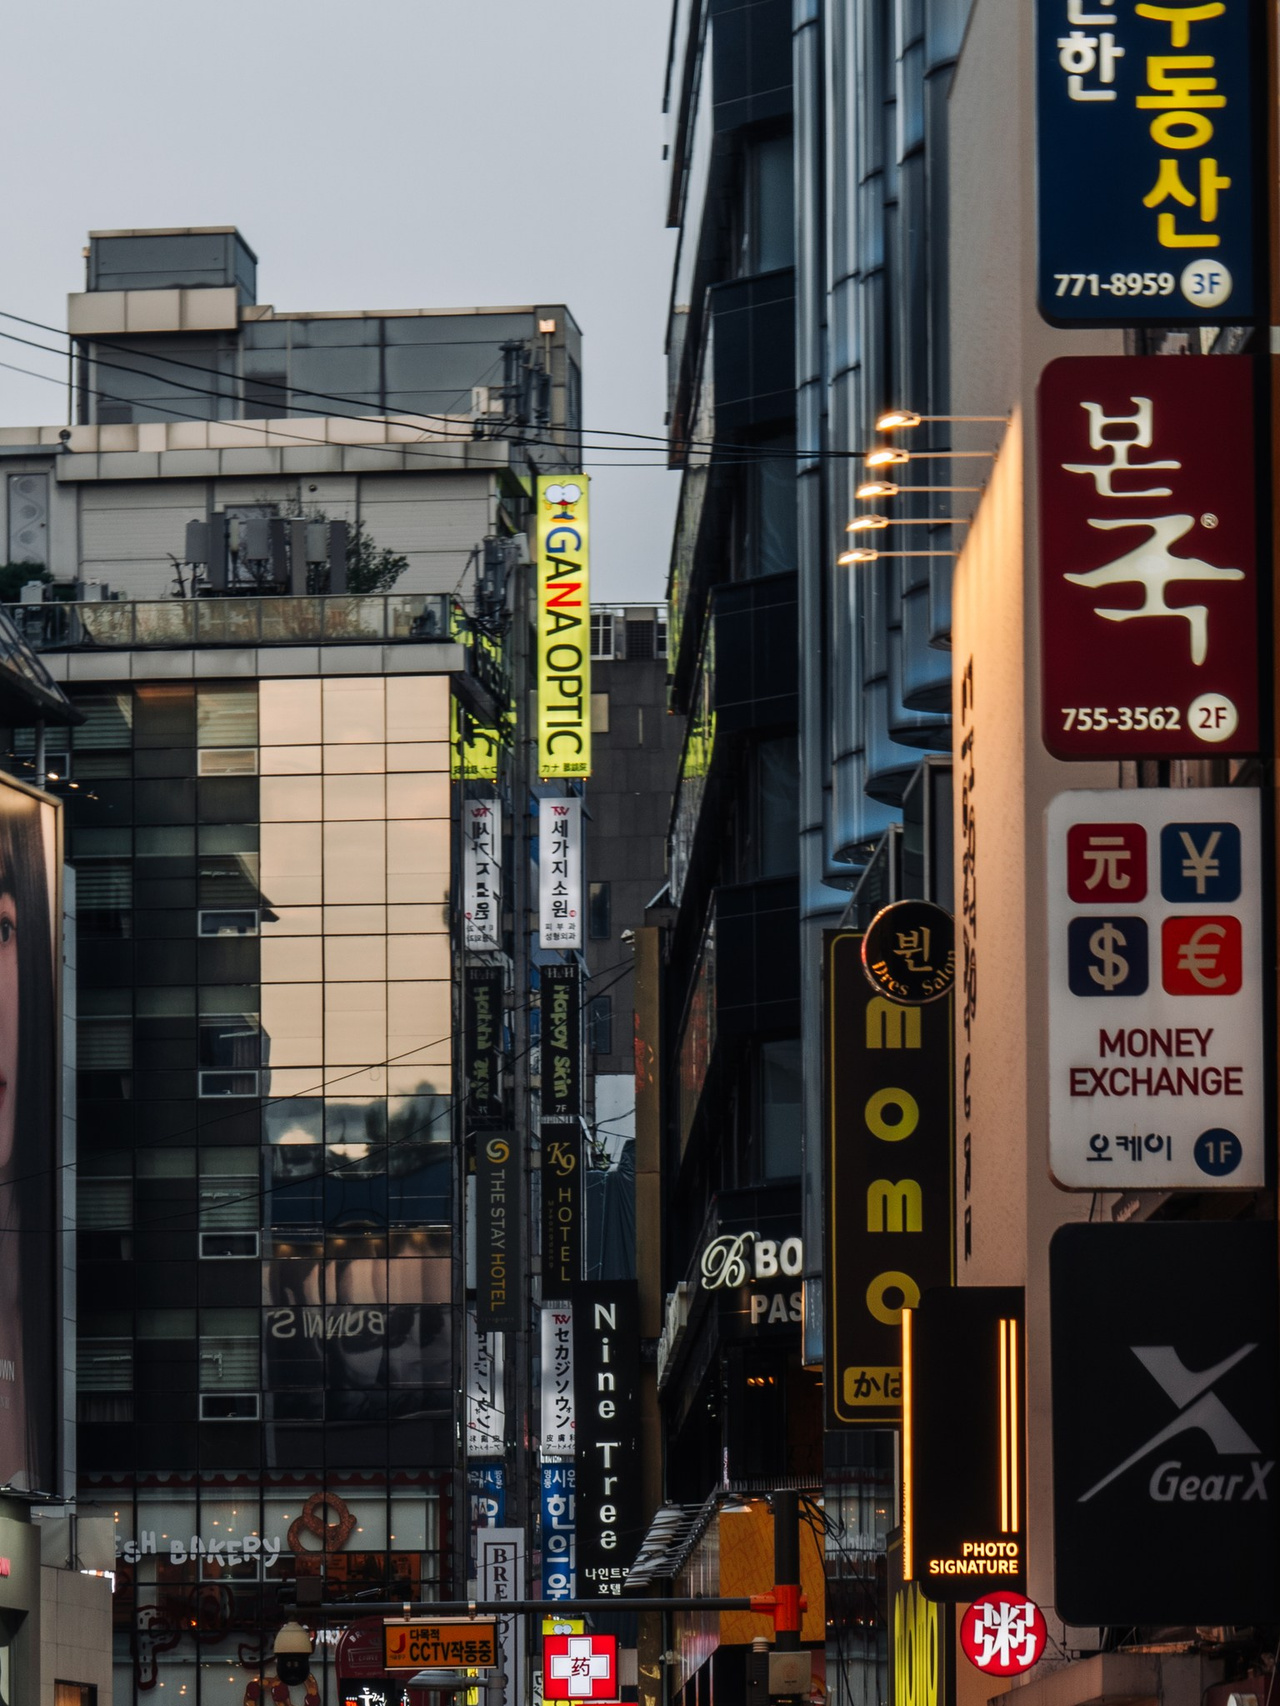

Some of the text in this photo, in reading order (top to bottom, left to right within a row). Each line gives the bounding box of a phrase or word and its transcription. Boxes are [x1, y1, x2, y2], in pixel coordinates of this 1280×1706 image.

[1053, 272, 1222, 297] 771-8959 3F
[1061, 396, 1246, 667] 본죽
[545, 526, 583, 756] GANA OPTIC
[1061, 706, 1228, 732] 755-3562 2F
[551, 819, 569, 918] 세가지소원
[1082, 836, 1131, 890] 元
[545, 932, 576, 941] 성형외과
[551, 985, 569, 1098] Happy Skin
[1098, 1028, 1214, 1057] MONEY
[1069, 1066, 1244, 1097] EXCHANGE
[555, 1105, 567, 1113] 7F
[547, 1142, 576, 1176] K9
[1085, 1132, 1233, 1162] 오케이 1F
[490, 1169, 506, 1312] THE STAY HOTEL
[558, 1187, 572, 1282] HOTEL
[594, 1303, 621, 1550] Nine Tree
[170, 1535, 281, 1568] BAKERY
[962, 1542, 1018, 1558] PHOTO
[929, 1559, 1019, 1575] SIGNATURE
[598, 1583, 621, 1596] 호텔
[410, 1629, 440, 1641] 다목적
[972, 1601, 1038, 1668] 粥
[410, 1640, 491, 1663] CCTV작동중
[571, 1657, 591, 1677] 药
